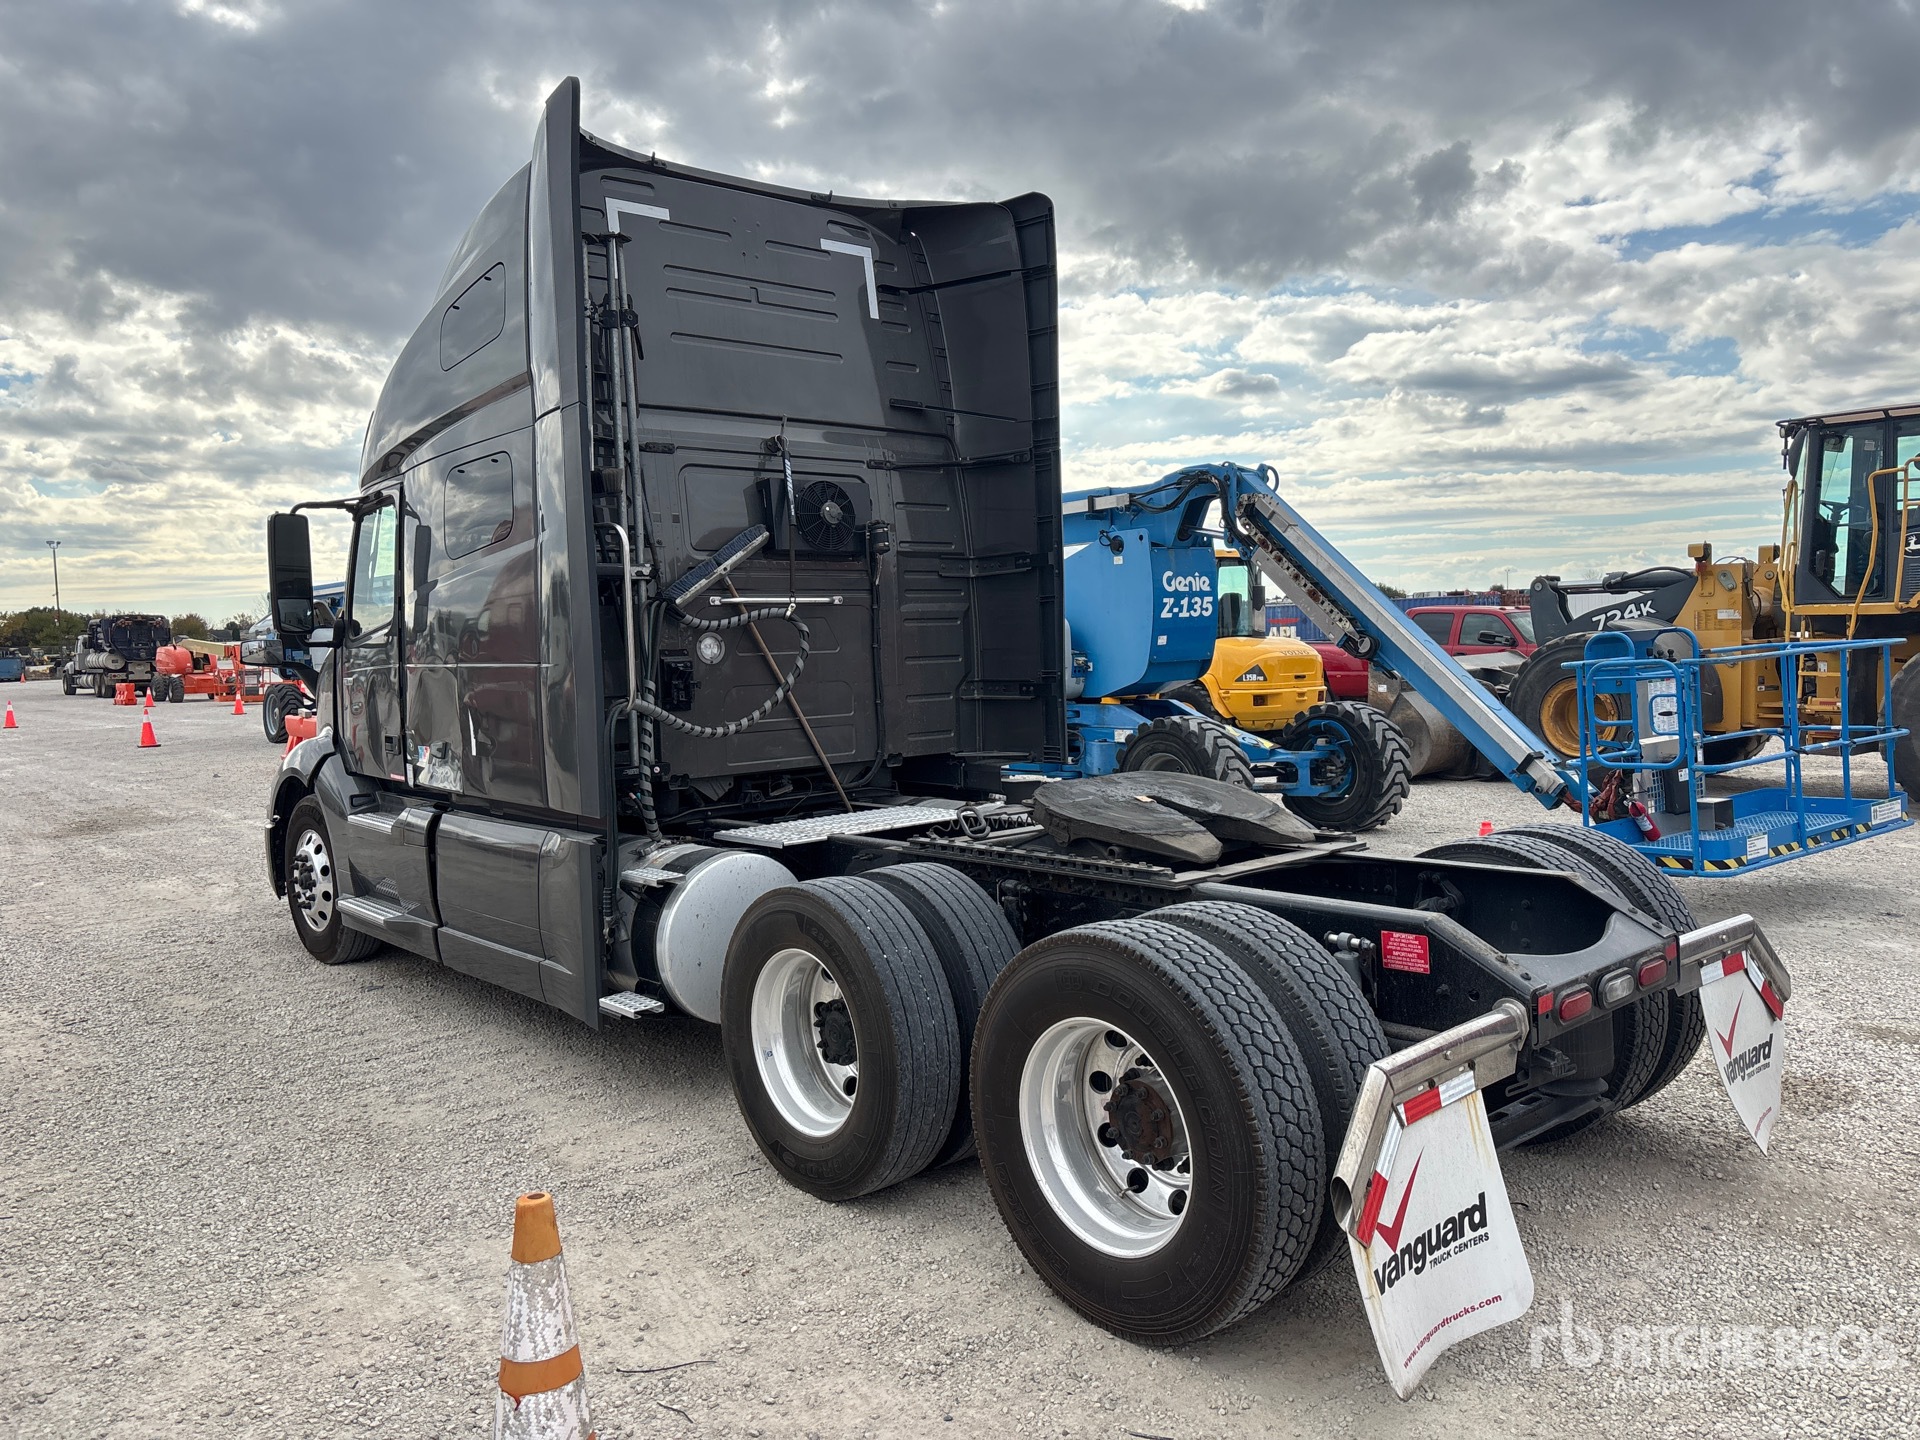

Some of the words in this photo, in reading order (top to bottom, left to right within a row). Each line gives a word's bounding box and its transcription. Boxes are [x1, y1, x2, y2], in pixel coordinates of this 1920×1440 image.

[1162, 571, 1212, 592] Genie
[1160, 596, 1213, 618] Z-135
[1591, 600, 1657, 631] 724K
[1723, 1033, 1773, 1086] vanguard
[1088, 976, 1205, 1091] DOUBLE
[1195, 1095, 1229, 1211] COIN
[1373, 1192, 1488, 1296] vanguard
[1429, 1250, 1452, 1270] TRUCK
[1453, 1232, 1490, 1255] CENTERS
[1403, 1293, 1503, 1369] www.vanguardtrucks.com
